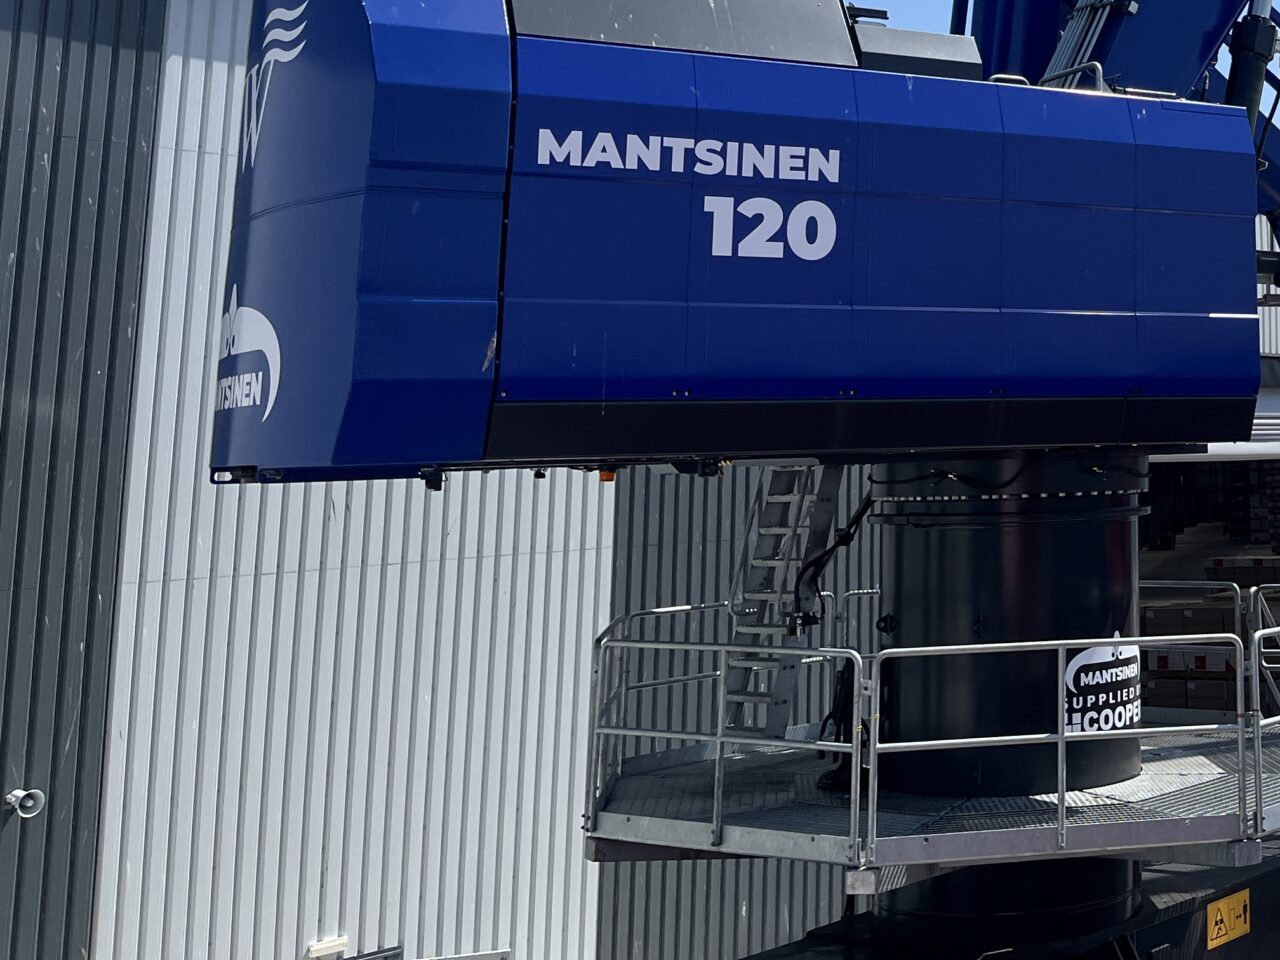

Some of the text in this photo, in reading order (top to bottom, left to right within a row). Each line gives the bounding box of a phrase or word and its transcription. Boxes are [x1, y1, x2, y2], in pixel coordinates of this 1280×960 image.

[537, 128, 840, 183] MANTSINEN
[704, 195, 837, 261] 120
[1080, 662, 1138, 687] MANTSINEN
